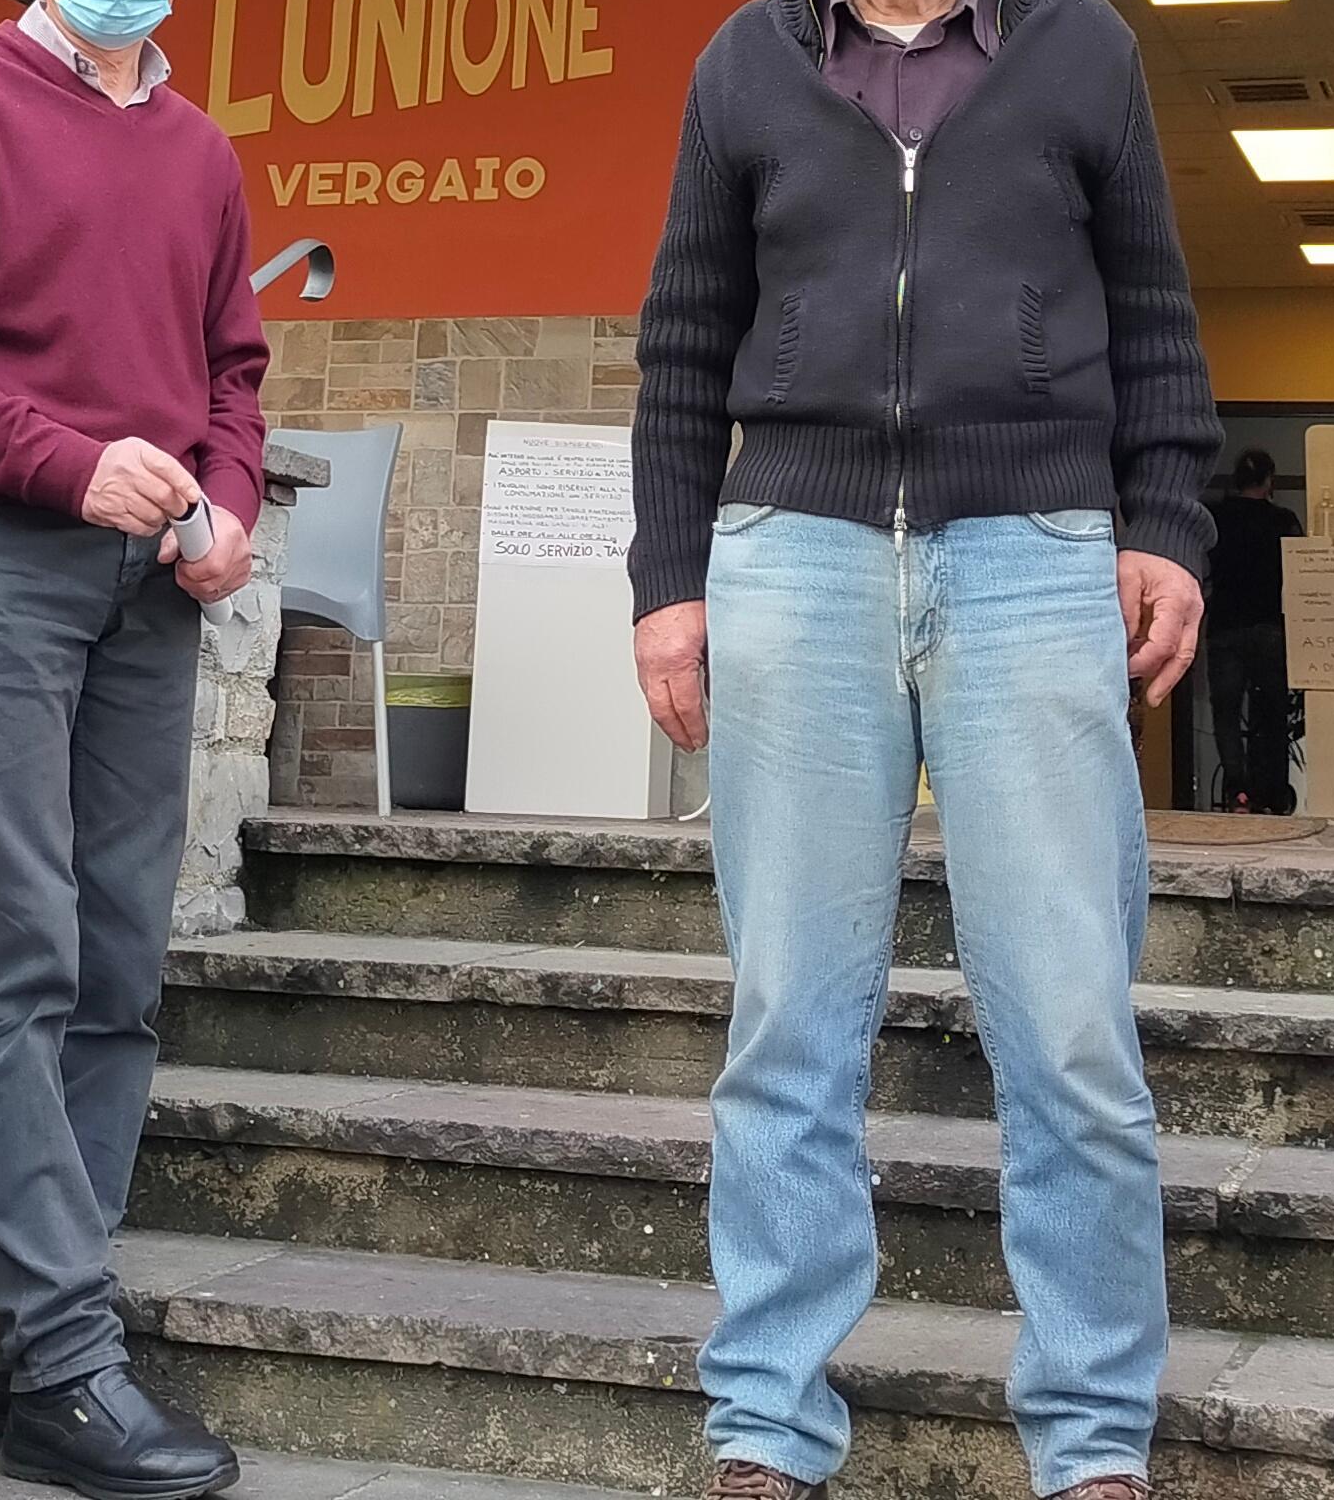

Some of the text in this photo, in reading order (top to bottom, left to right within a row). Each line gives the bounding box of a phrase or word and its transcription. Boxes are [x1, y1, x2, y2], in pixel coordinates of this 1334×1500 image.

[267, 156, 546, 207] VERGAIO
[604, 469, 631, 478] TAVOL
[494, 541, 531, 556] SOLO
